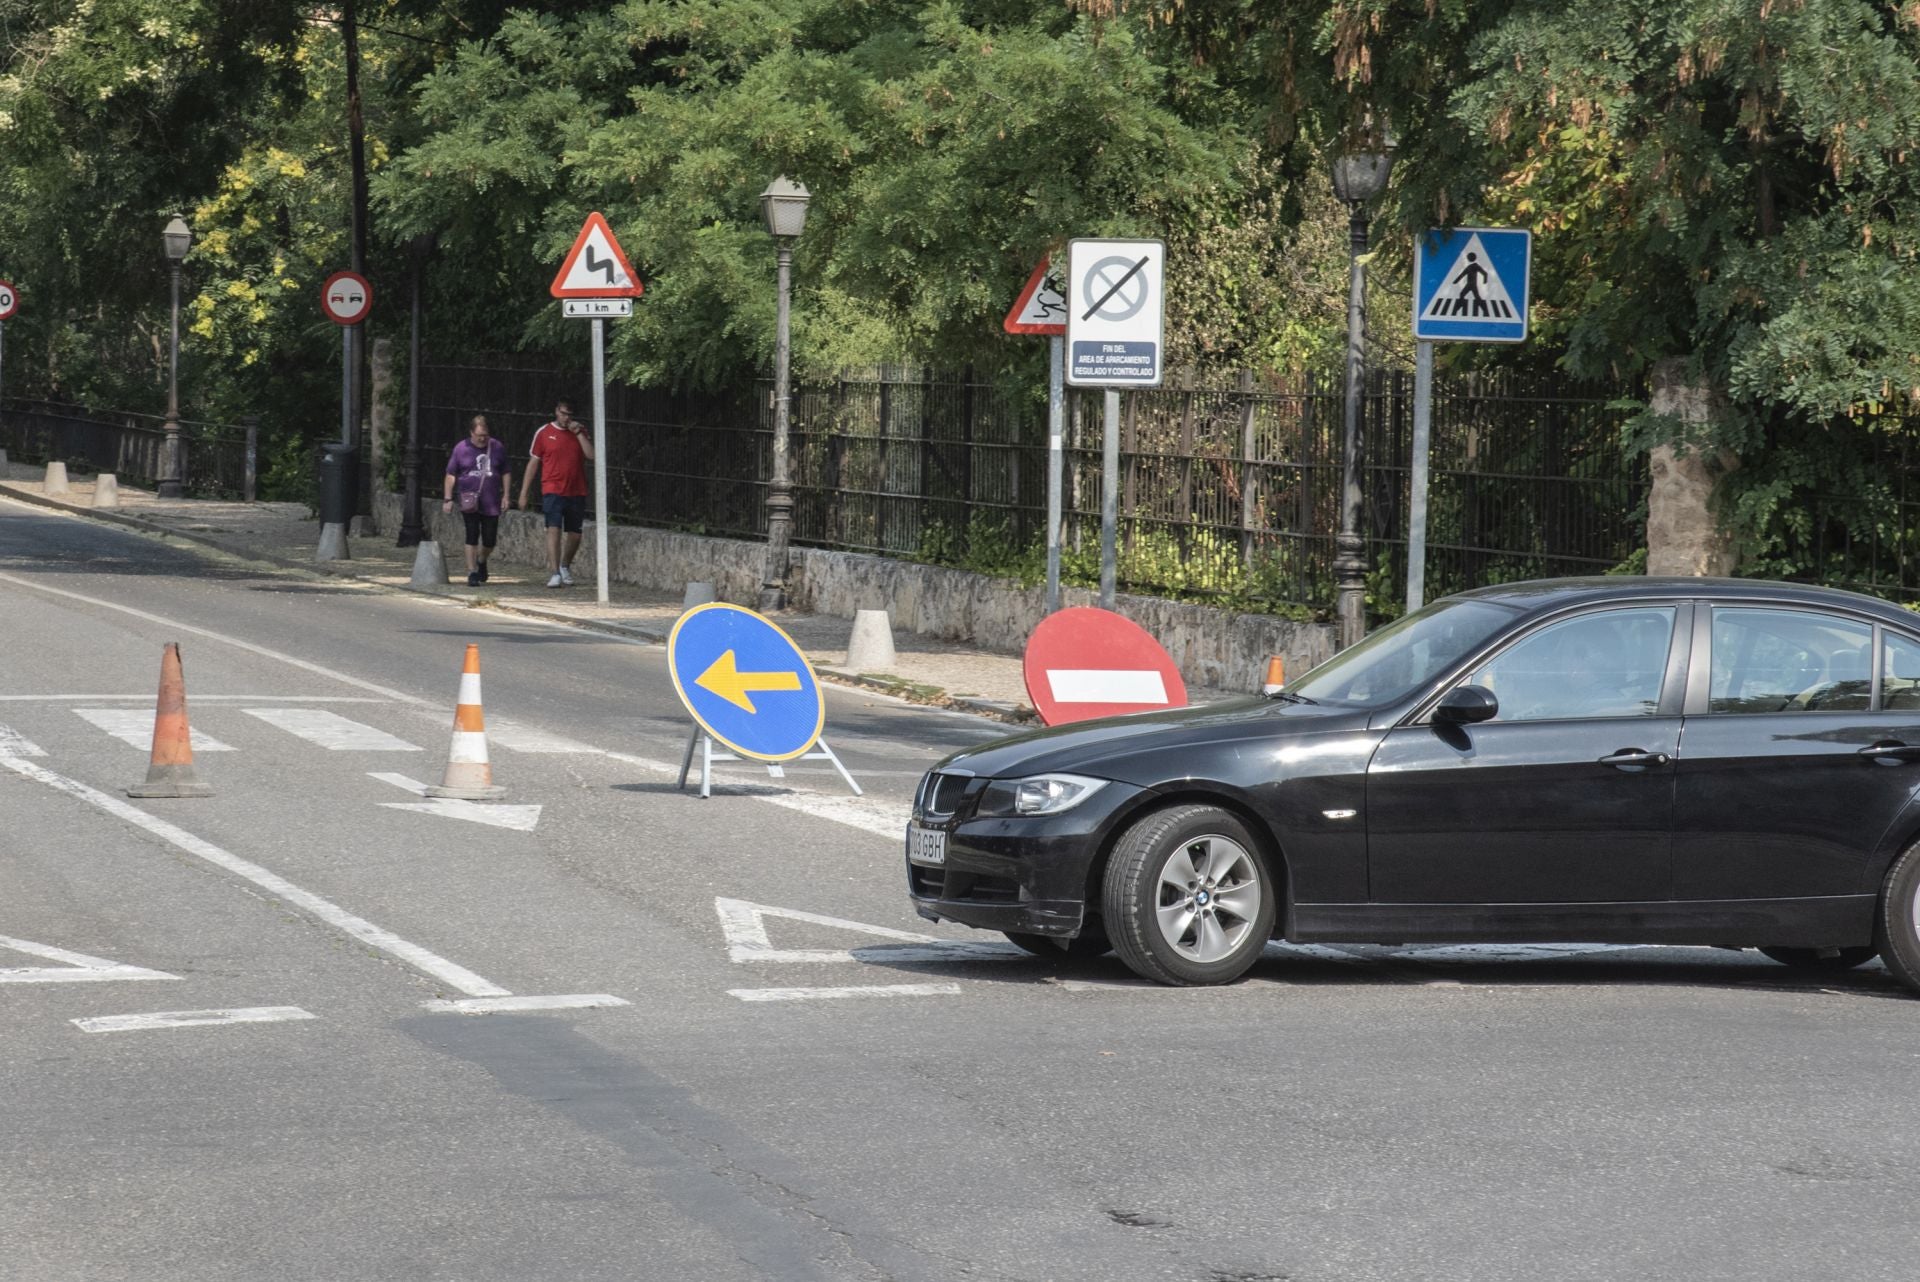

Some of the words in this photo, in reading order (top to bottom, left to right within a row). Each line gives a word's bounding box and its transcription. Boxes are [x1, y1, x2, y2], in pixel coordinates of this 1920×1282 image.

[585, 304, 590, 312] 1
[595, 303, 609, 312] km
[1103, 344, 1113, 353] FIN
[1114, 345, 1126, 353] DEL
[1079, 355, 1095, 364] AREA
[1095, 356, 1105, 364] DE
[1105, 356, 1151, 364] APARCAMIENTO
[1074, 367, 1107, 375] REGULADO
[1112, 368, 1154, 376] CONTROLADO
[923, 833, 942, 859] GBH
